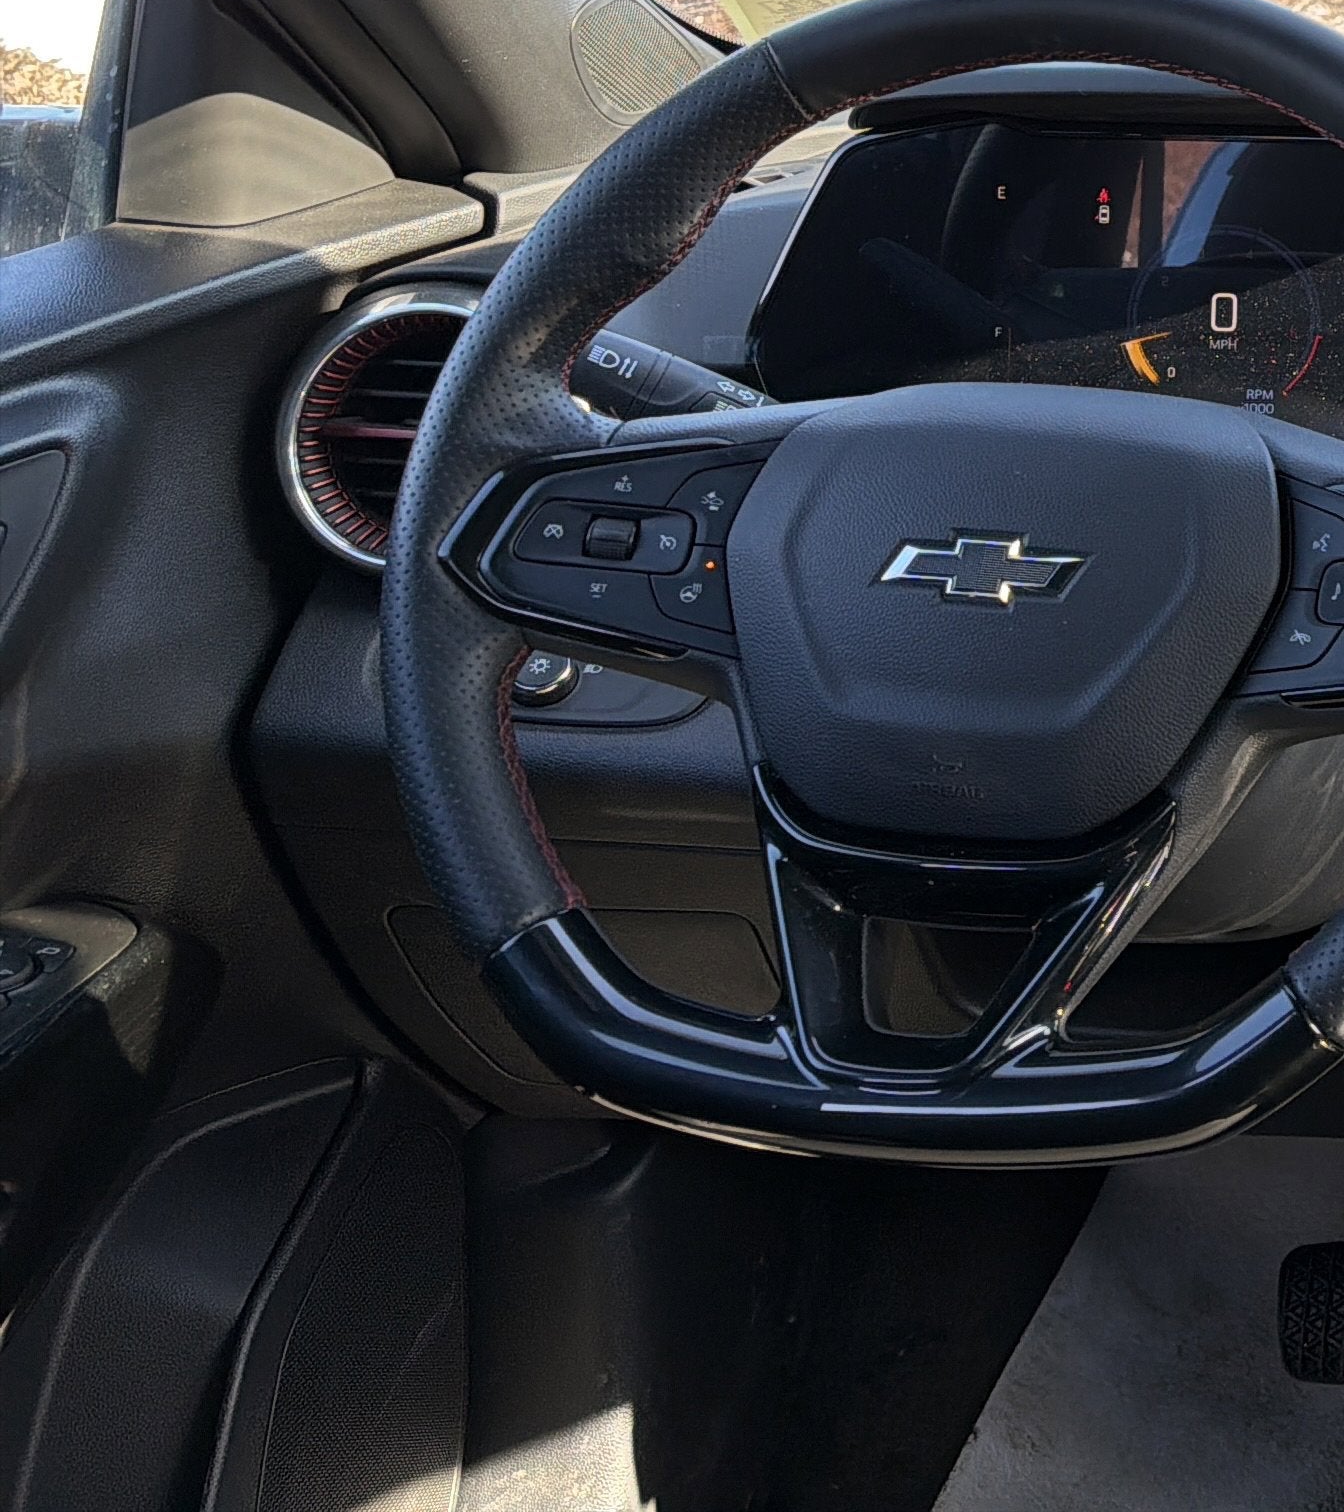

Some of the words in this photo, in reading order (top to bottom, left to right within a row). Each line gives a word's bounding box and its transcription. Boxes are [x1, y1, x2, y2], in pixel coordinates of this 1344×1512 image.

[997, 185, 1006, 200] E
[1210, 292, 1238, 333] 0
[1209, 339, 1239, 351] MPH
[1246, 388, 1274, 401] RPM
[614, 481, 632, 493] RES
[589, 583, 608, 593] SET
